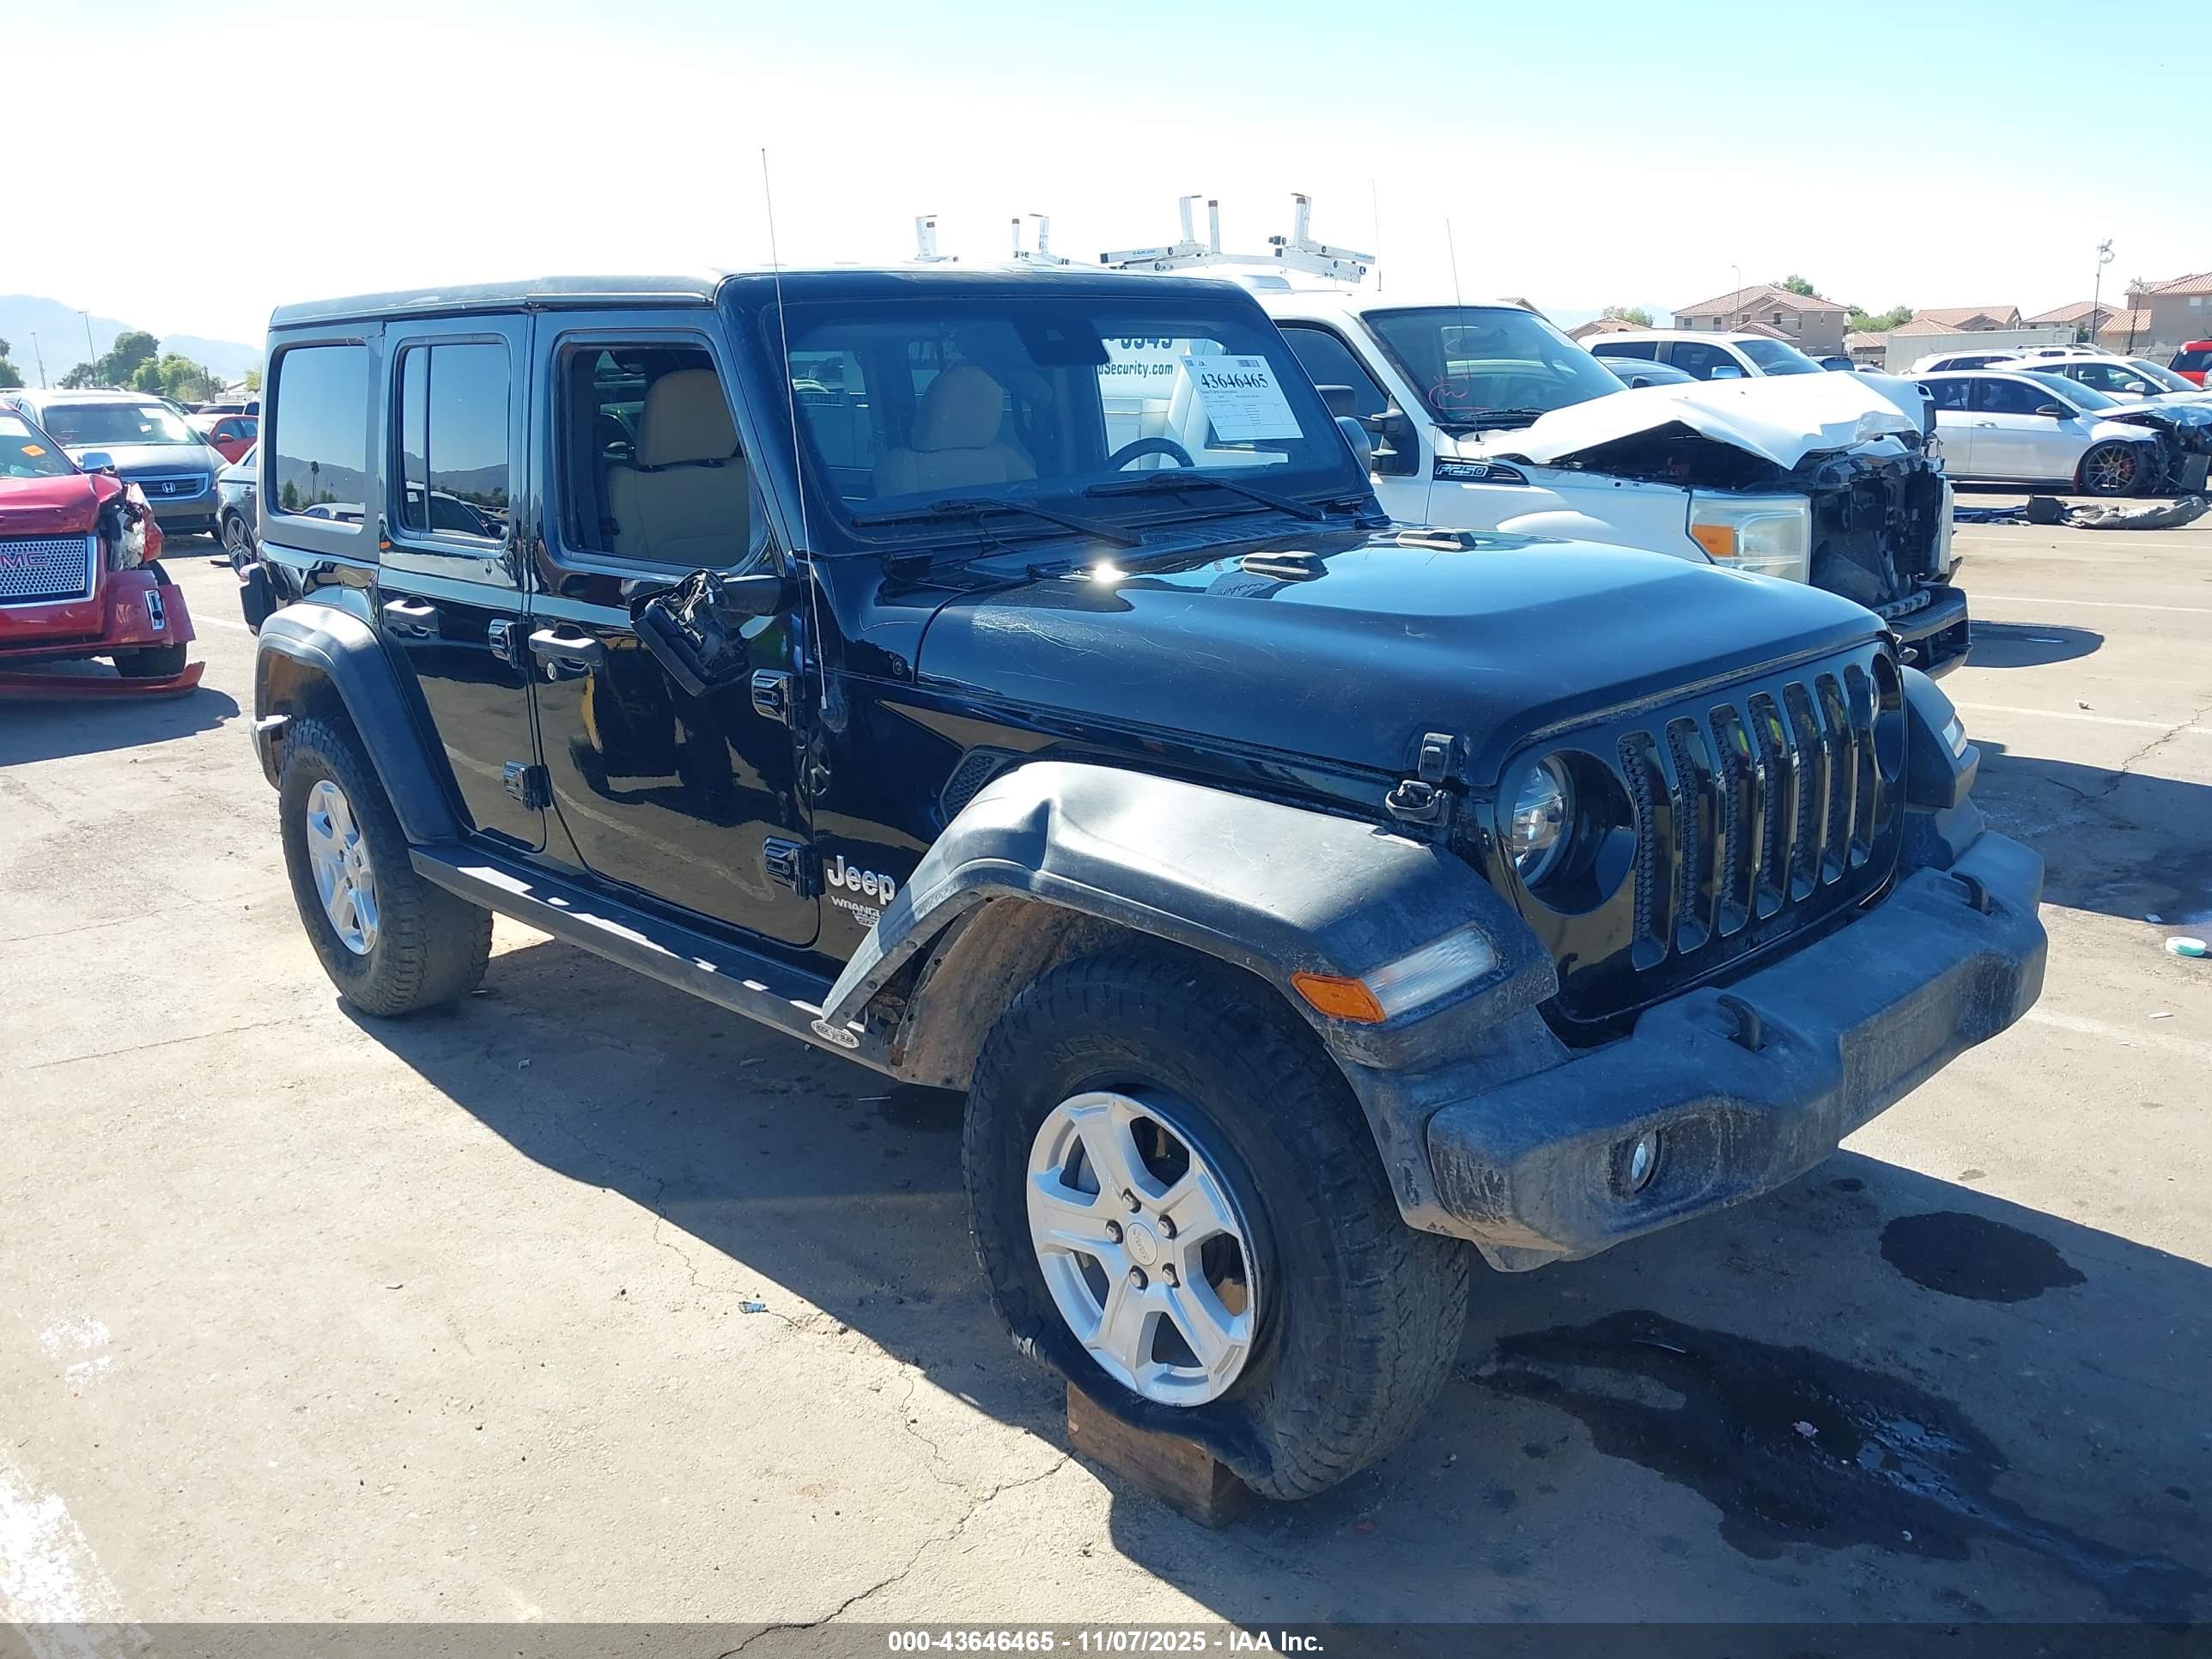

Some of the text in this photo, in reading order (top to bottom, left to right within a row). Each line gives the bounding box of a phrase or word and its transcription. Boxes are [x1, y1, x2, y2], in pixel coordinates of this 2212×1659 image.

[1200, 373, 1269, 389] 43646465
[0, 551, 49, 568] MC
[827, 854, 896, 905] Jeep
[830, 896, 884, 917] WRANG
